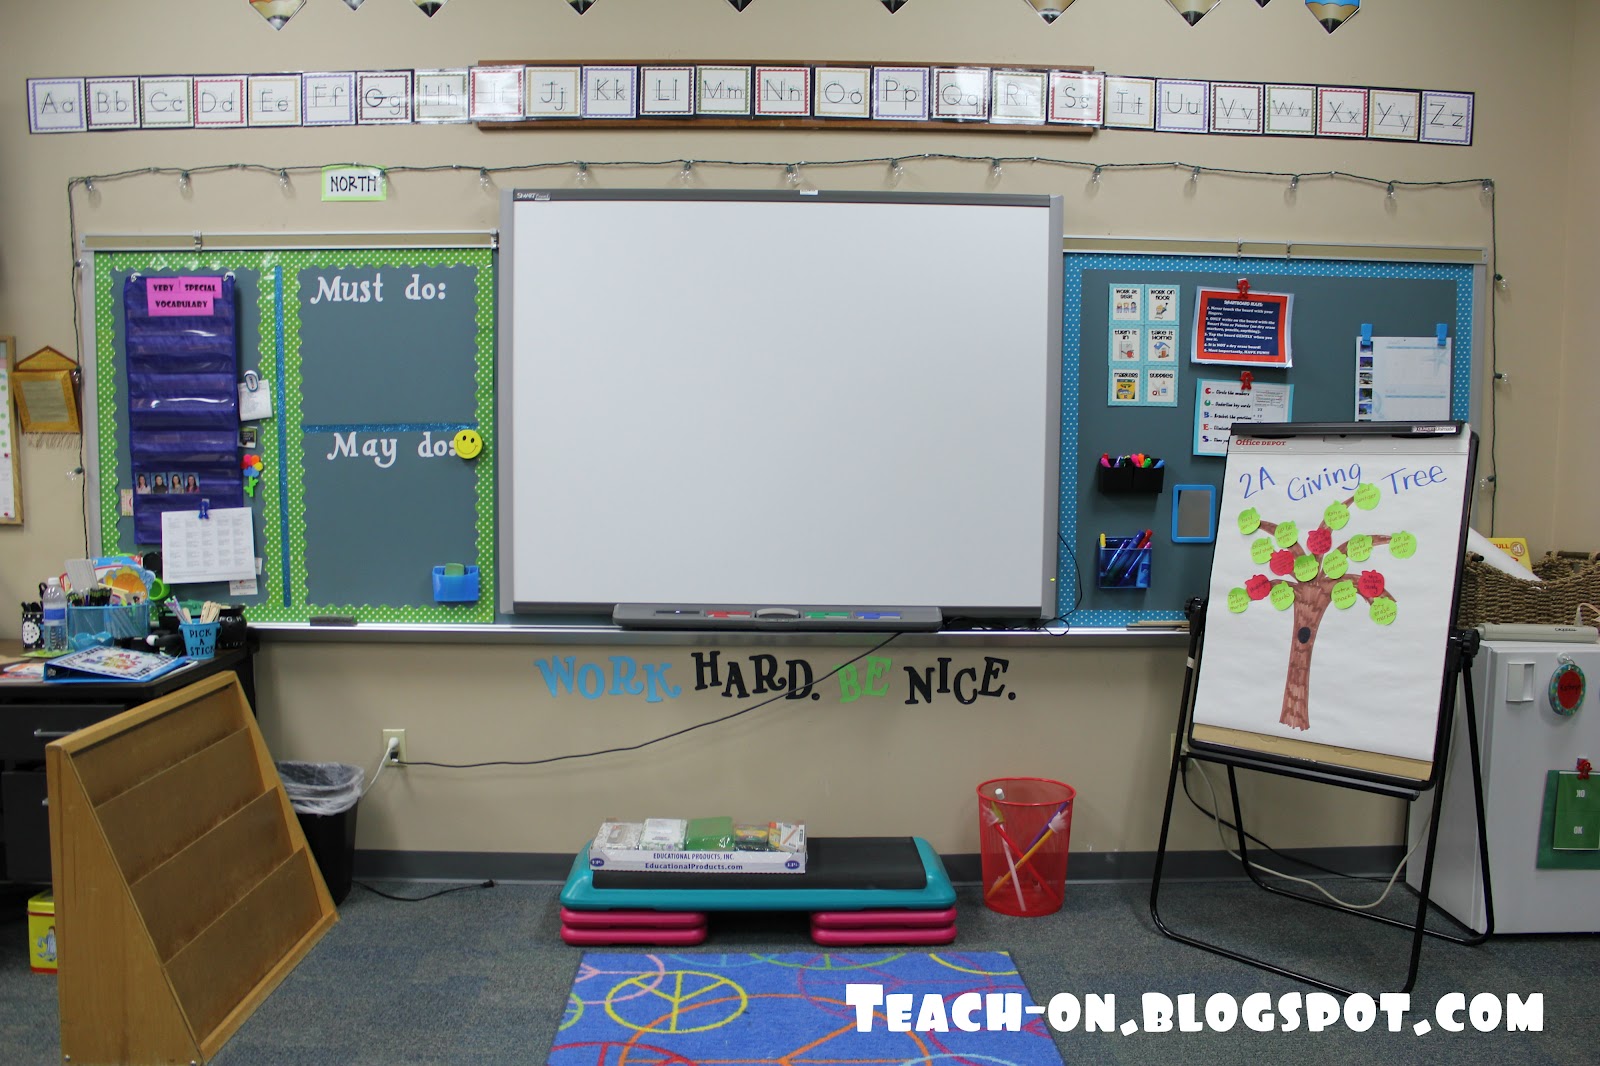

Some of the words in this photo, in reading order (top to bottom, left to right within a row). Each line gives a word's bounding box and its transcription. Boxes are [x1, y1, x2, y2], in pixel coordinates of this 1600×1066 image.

[330, 175, 378, 192] NORTH
[152, 284, 174, 292] VERY
[184, 284, 216, 292] SPECIAL
[310, 272, 384, 304] Must
[404, 274, 446, 301] do:
[155, 300, 208, 308] VOCABULARY
[326, 431, 398, 468] May
[1239, 466, 1276, 499] 2A
[1287, 463, 1361, 501] Giving
[1380, 465, 1447, 495] Tree
[190, 628, 212, 638] PICK
[534, 655, 682, 703] WORK
[690, 650, 820, 701] HARD.
[834, 656, 892, 703] BE
[904, 656, 1017, 704] NICE.
[1574, 826, 1582, 834] OK
[645, 862, 743, 871] EducationalProducts.com
